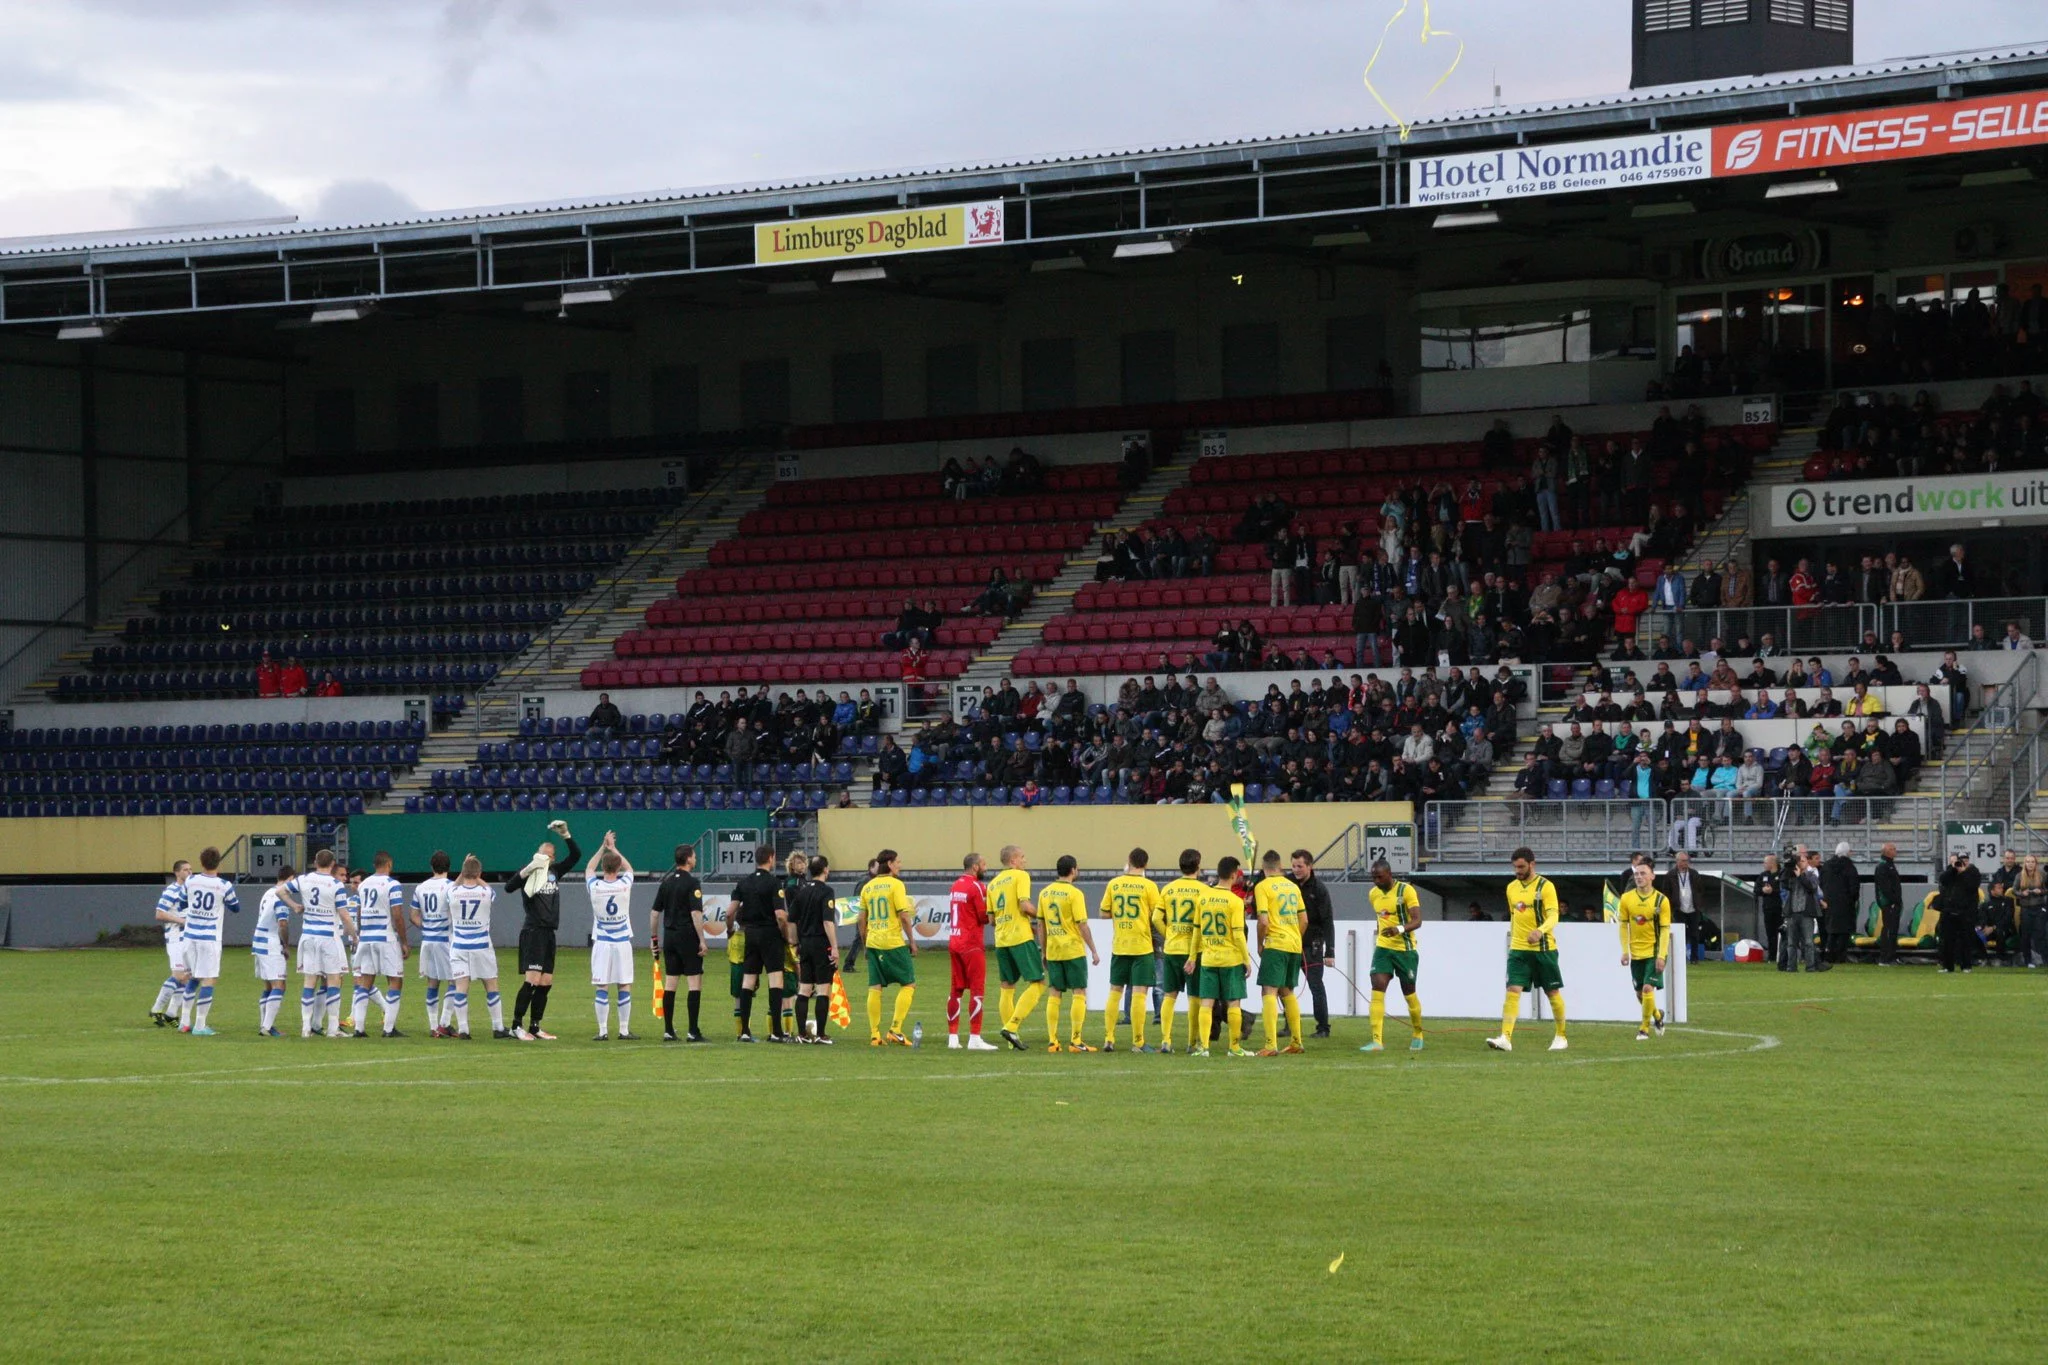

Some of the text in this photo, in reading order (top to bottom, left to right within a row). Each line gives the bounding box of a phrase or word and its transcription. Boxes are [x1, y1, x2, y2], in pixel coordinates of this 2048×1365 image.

[1418, 134, 1703, 189] Hotel Normandie
[1418, 165, 1703, 203] Wolfstraat 7 6162 BB Geleen 046 4759670
[773, 213, 947, 253] Limburgs Dagblad
[1728, 242, 1796, 271] Brand
[1822, 481, 2005, 517] trendwork
[880, 698, 895, 713] F1
[960, 697, 977, 713] F2
[729, 833, 744, 841] VAK
[1380, 828, 1398, 836] VAK
[1962, 825, 1984, 834] VAK
[261, 838, 276, 846] VAK
[1977, 843, 1996, 858] F3
[257, 855, 283, 867] B F1
[722, 851, 754, 863] F1 F2
[1370, 847, 1386, 860] F2
[192, 890, 215, 911] 30
[310, 887, 320, 906] 3
[363, 888, 378, 908] 19
[423, 893, 438, 913] 10
[606, 895, 618, 916] 6
[996, 892, 1006, 910] 4
[460, 900, 481, 920] 17
[869, 896, 889, 920] 10
[952, 903, 959, 927] 1
[1049, 903, 1061, 926] 3
[1114, 895, 1140, 919] 35
[1171, 899, 1195, 923] 12
[1201, 911, 1227, 936] 26
